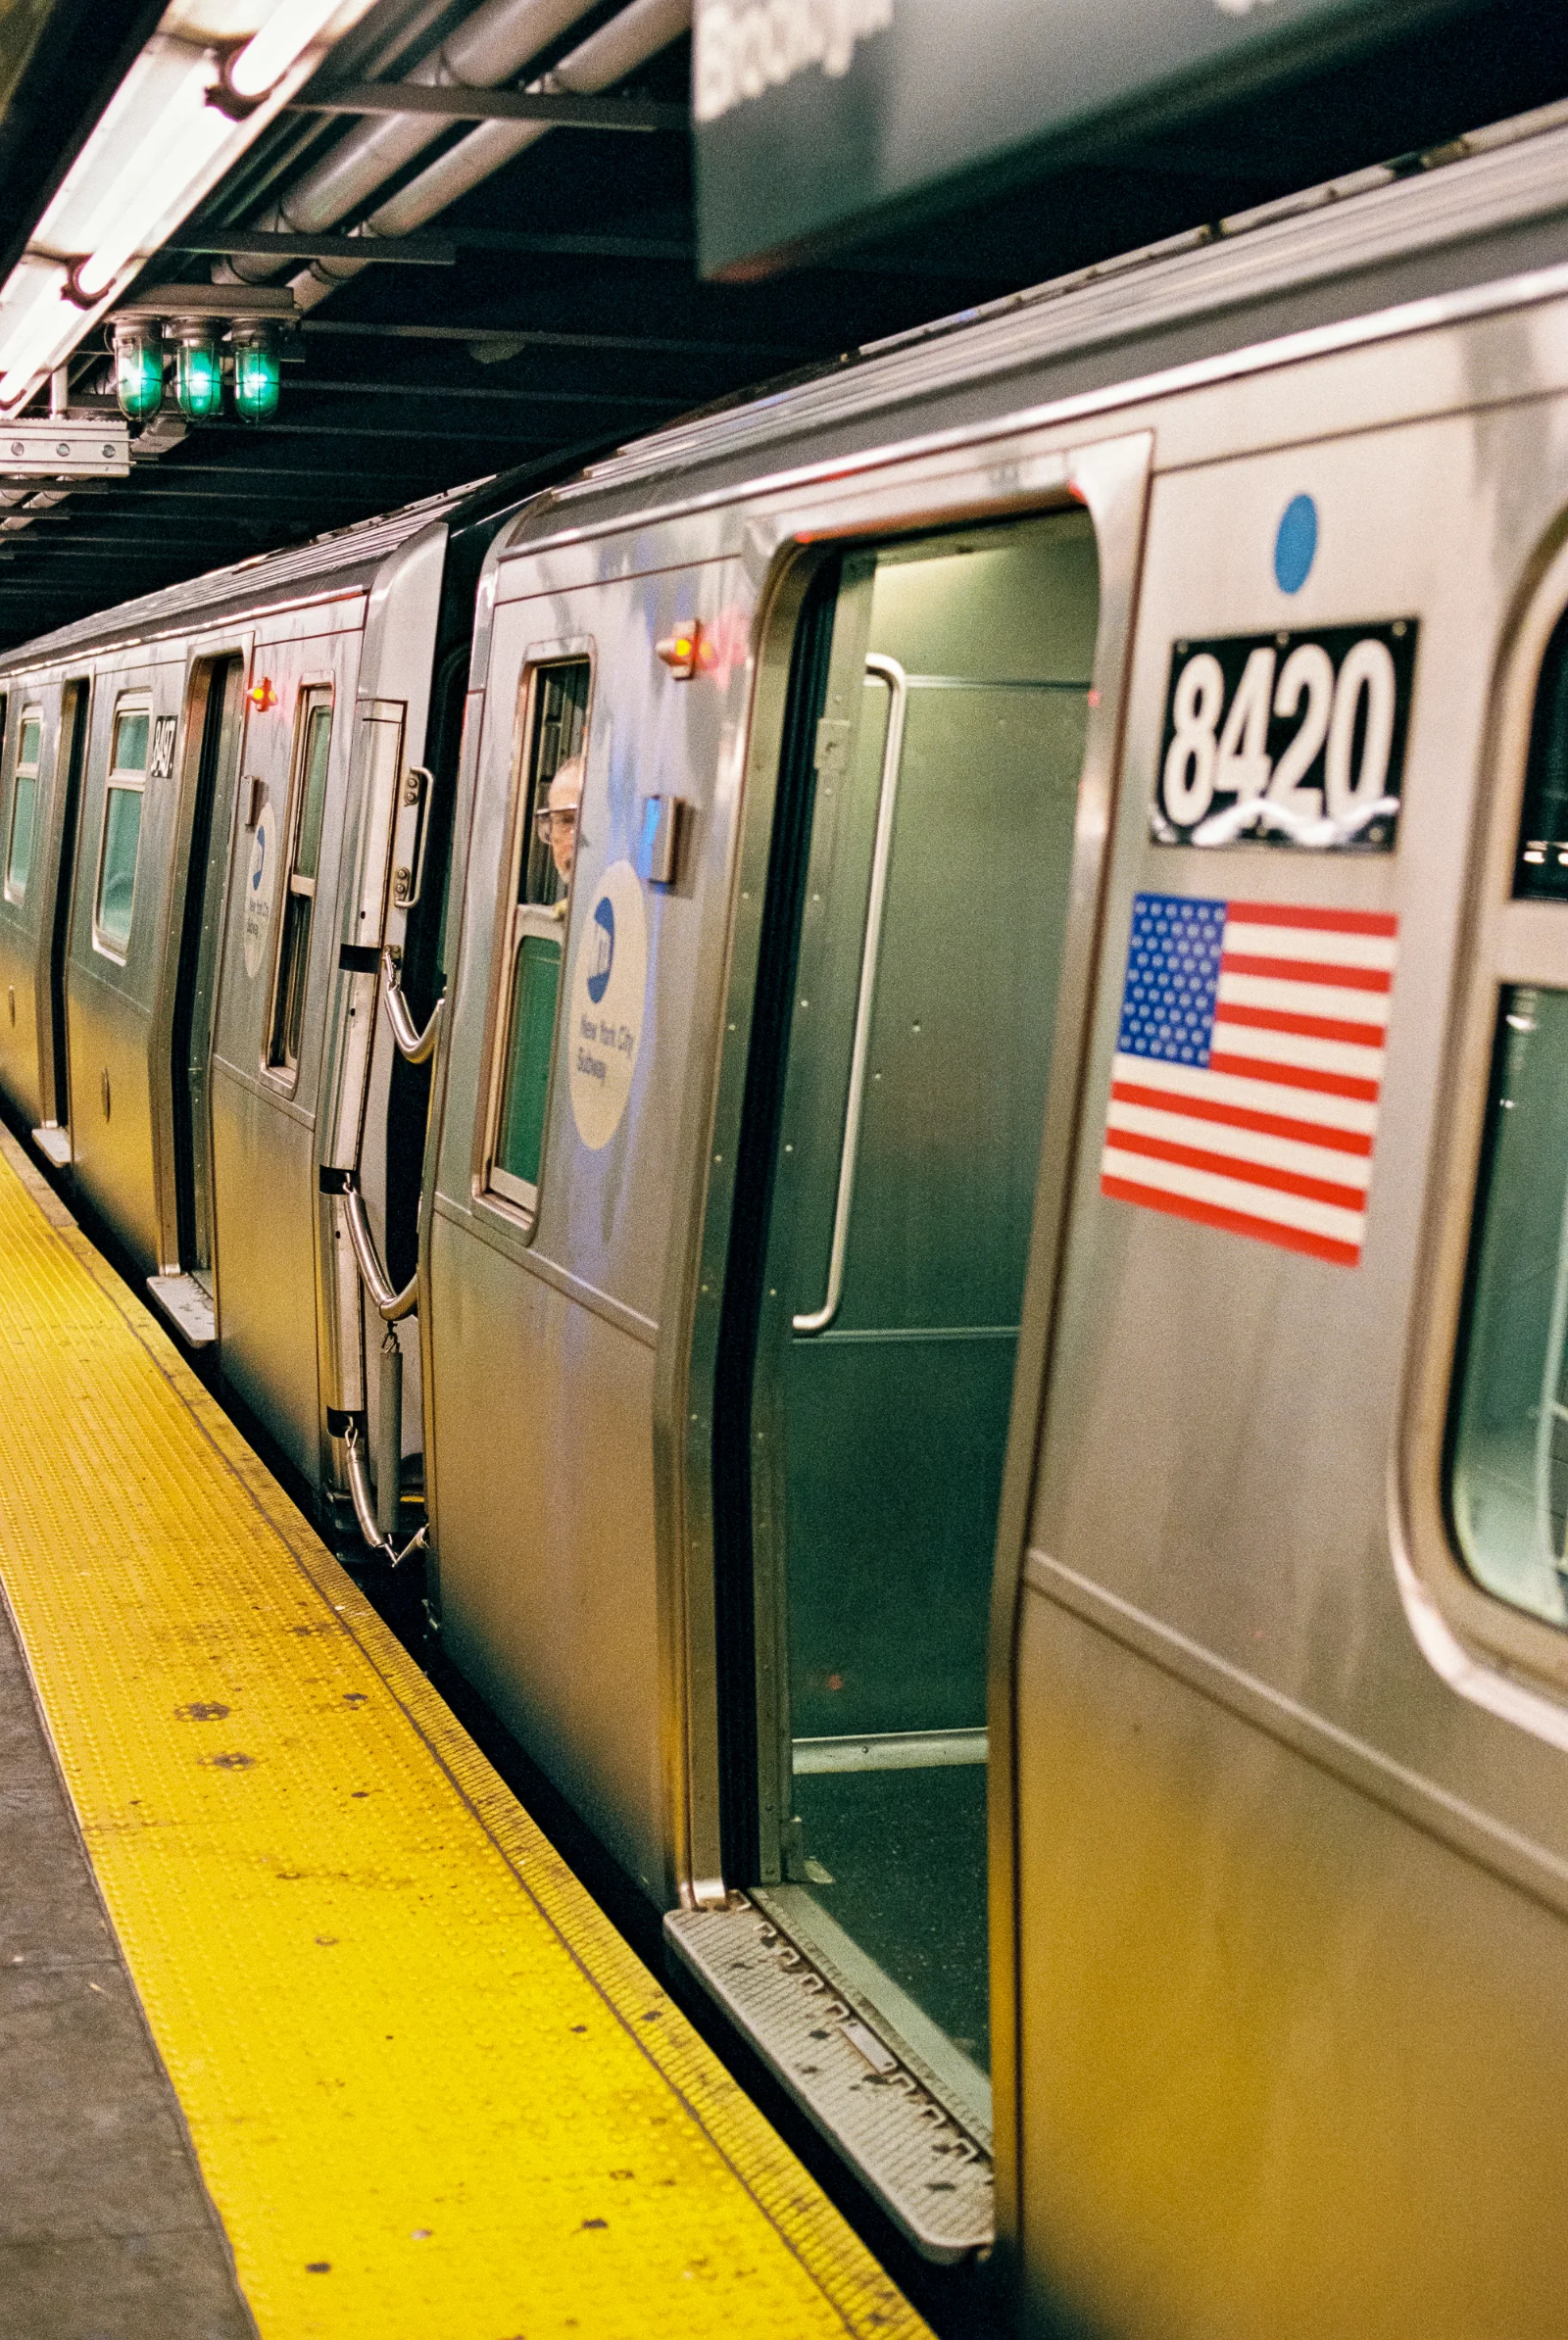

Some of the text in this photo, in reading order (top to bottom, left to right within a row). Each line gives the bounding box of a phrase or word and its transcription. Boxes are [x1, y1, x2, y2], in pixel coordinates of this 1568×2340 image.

[1163, 638, 1396, 829] 8420
[580, 1014, 597, 1041] New
[617, 1026, 634, 1060] City
[576, 1046, 607, 1087] Subway
